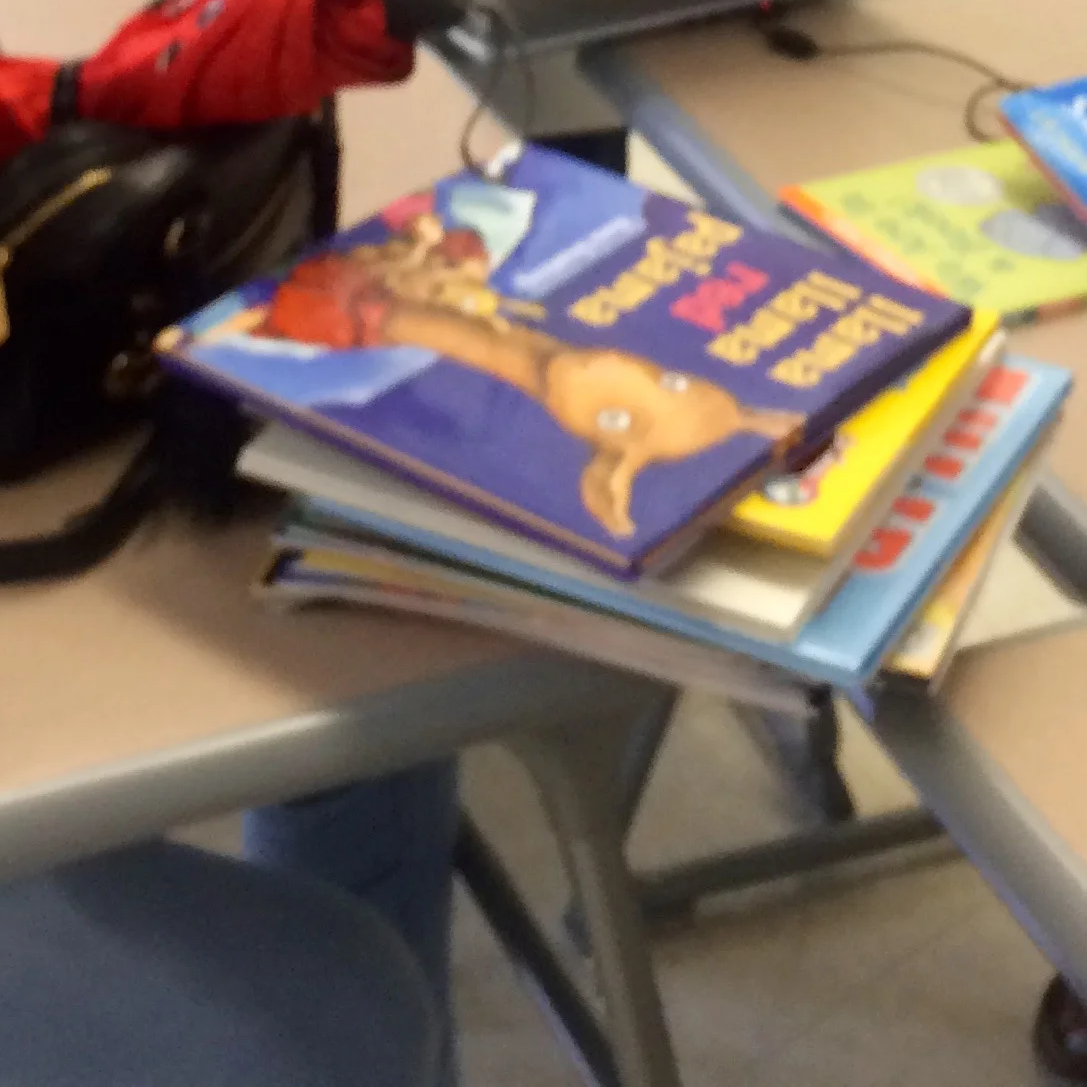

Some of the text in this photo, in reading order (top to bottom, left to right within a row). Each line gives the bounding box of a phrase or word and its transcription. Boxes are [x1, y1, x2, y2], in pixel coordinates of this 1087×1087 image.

[568, 212, 744, 326] pajama
[670, 261, 770, 333] red
[706, 270, 862, 366] llama
[768, 293, 924, 387] llama
